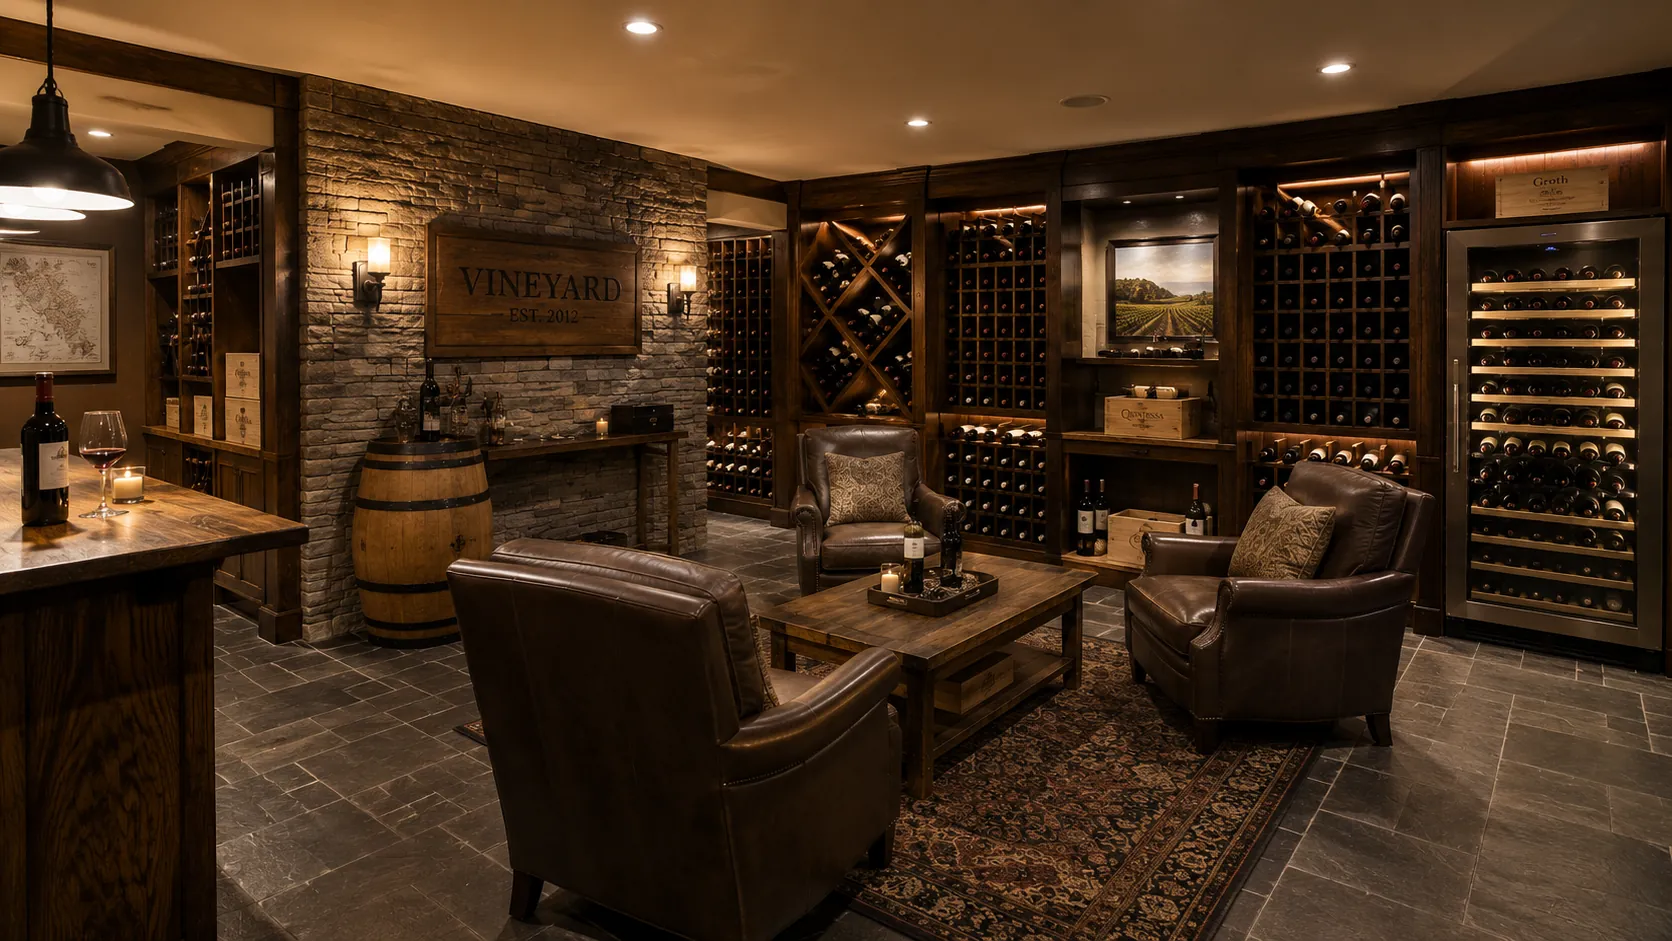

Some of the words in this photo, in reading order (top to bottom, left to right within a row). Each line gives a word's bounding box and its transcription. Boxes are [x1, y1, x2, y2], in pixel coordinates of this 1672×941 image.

[1533, 175, 1568, 187] Groth
[459, 266, 621, 302] VINEYARD
[509, 308, 541, 323] EST.
[547, 309, 579, 324] 2012
